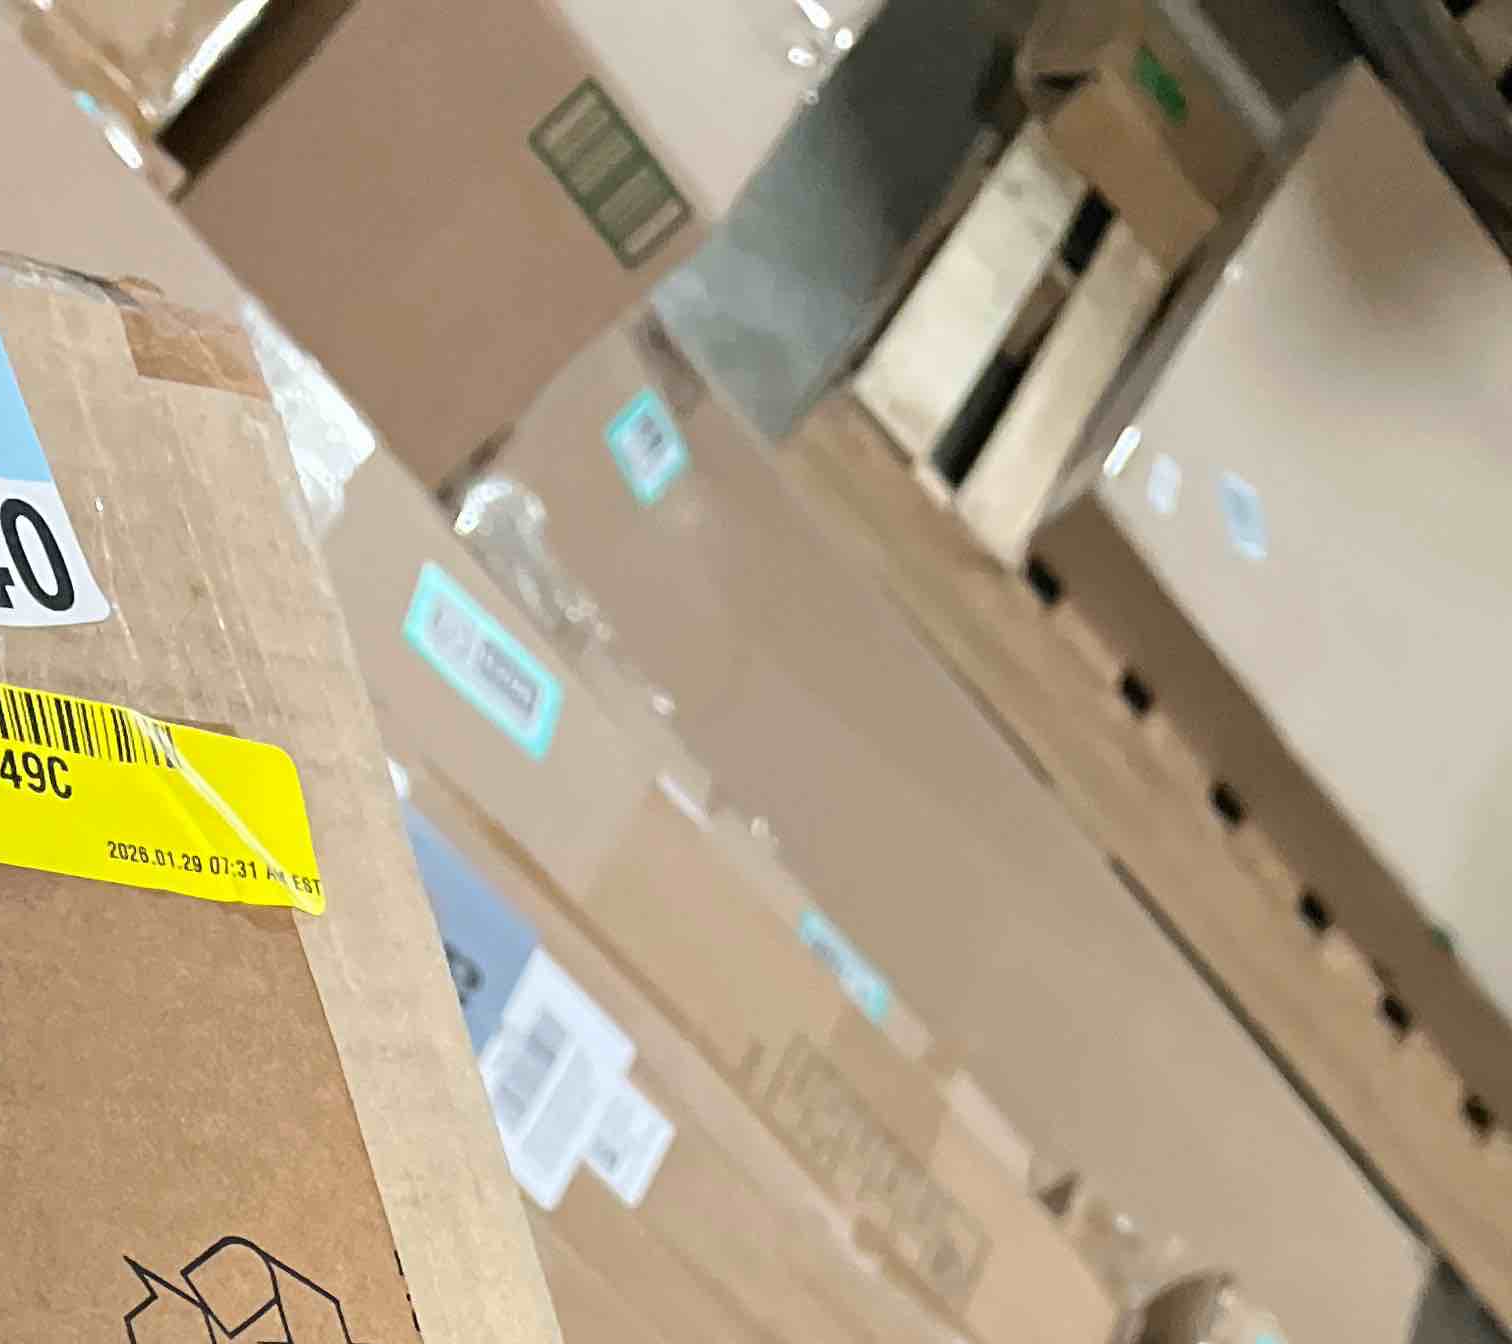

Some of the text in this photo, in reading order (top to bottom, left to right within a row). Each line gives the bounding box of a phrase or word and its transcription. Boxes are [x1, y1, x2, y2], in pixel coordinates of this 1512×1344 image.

[107, 840, 203, 873] 2026.01.29
[209, 856, 257, 881] 07:31
[293, 874, 321, 897] EST
